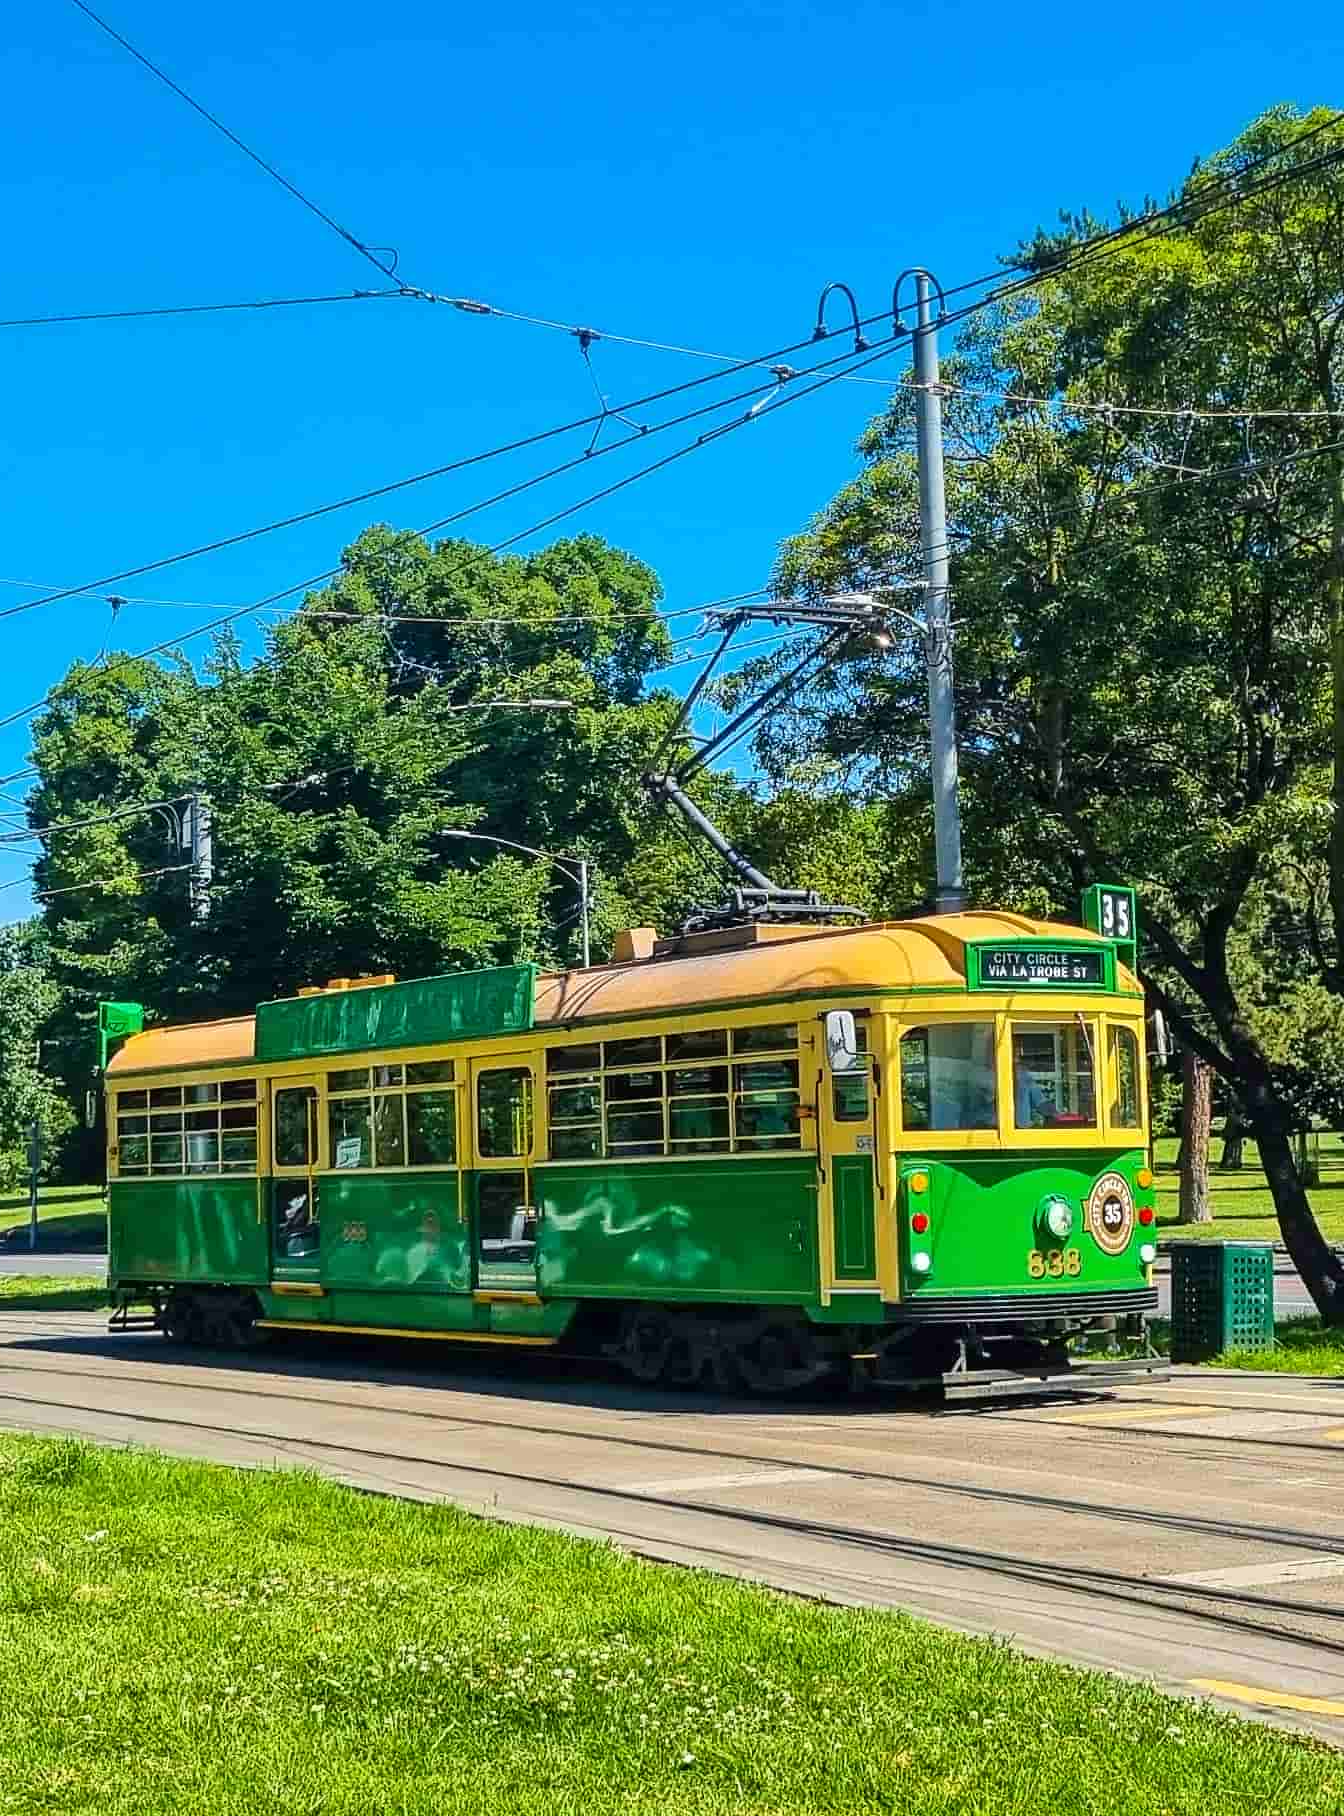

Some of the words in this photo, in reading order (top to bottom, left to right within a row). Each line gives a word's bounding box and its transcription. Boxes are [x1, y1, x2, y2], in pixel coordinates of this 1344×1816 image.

[1103, 894, 1129, 937] 35
[993, 953, 1020, 964] CITY
[1026, 953, 1069, 965] CIRCLE
[989, 964, 1007, 977] VIA
[1073, 966, 1088, 978] ST
[1104, 1203, 1122, 1224] 35
[1028, 1248, 1080, 1278] 838
